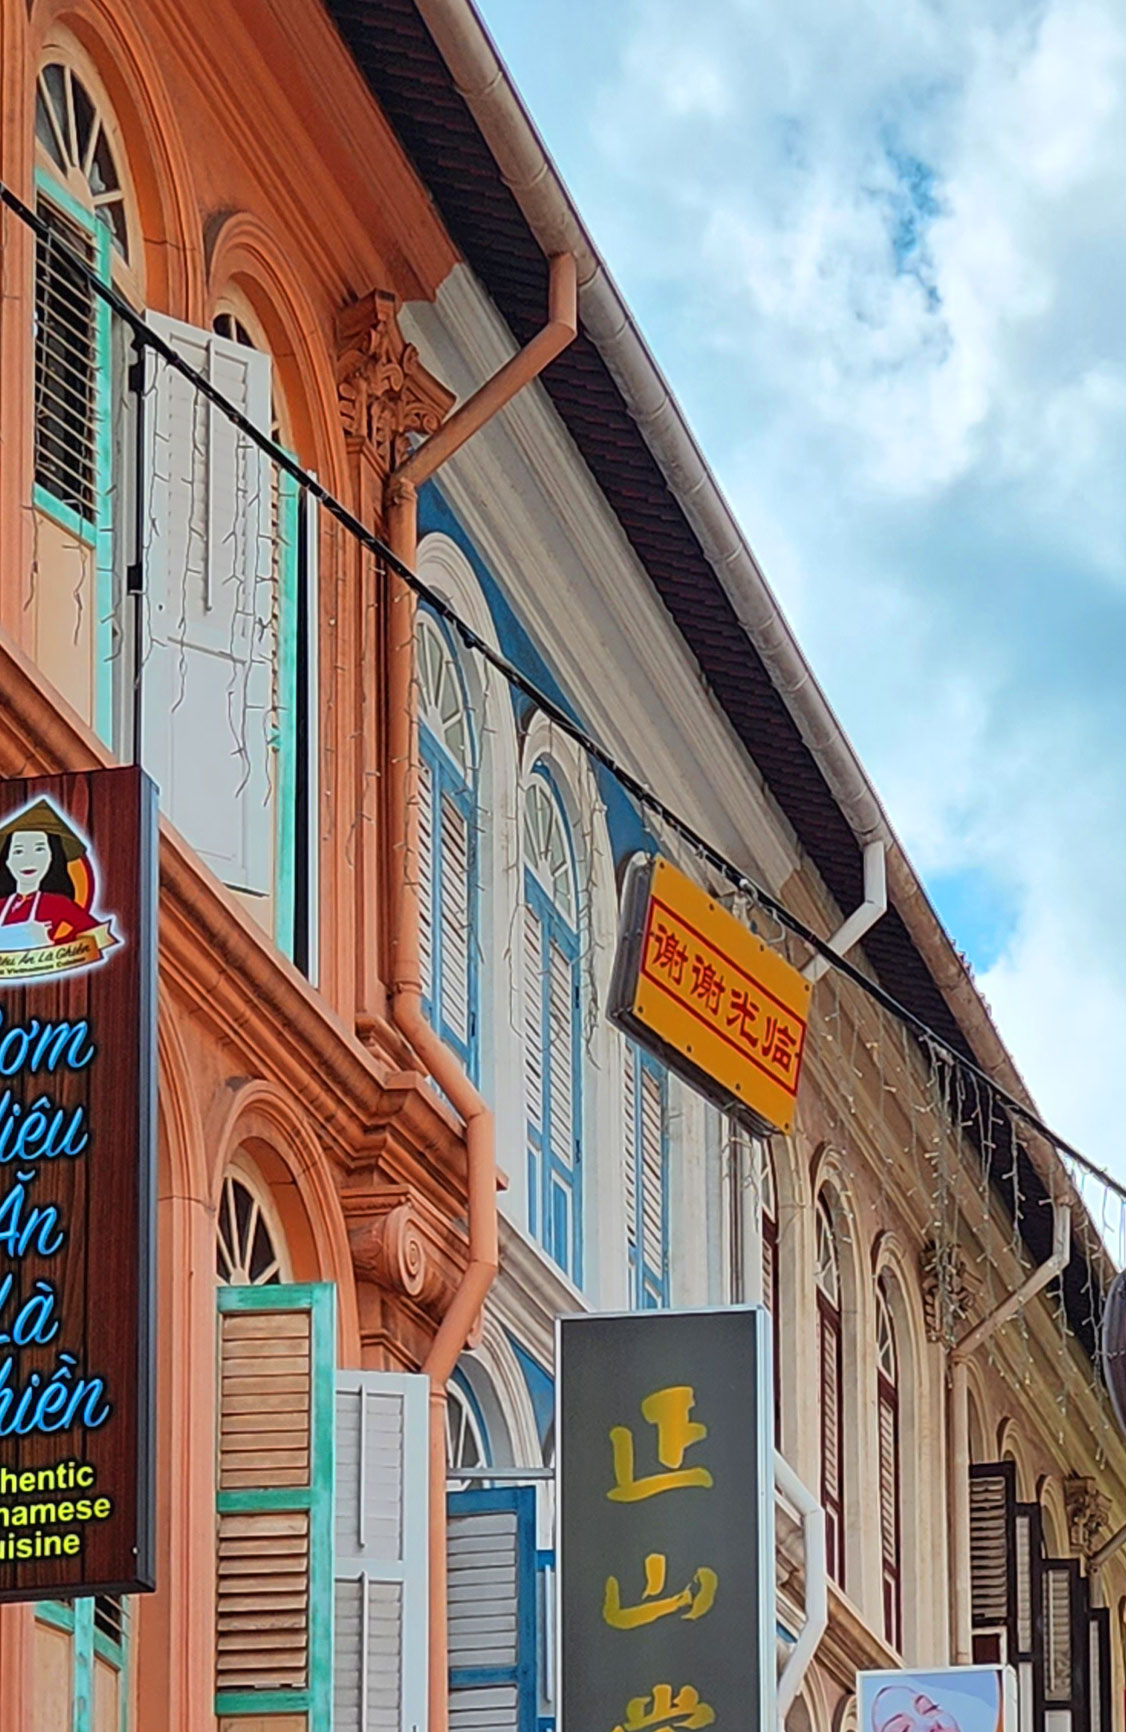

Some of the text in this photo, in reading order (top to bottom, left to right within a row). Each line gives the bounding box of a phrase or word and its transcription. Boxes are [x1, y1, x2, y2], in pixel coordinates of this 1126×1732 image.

[652, 922, 797, 1073] 谢谢光临
[0, 1020, 94, 1075] ơm
[0, 1090, 88, 1163] iêu
[0, 1462, 94, 1493] hentic
